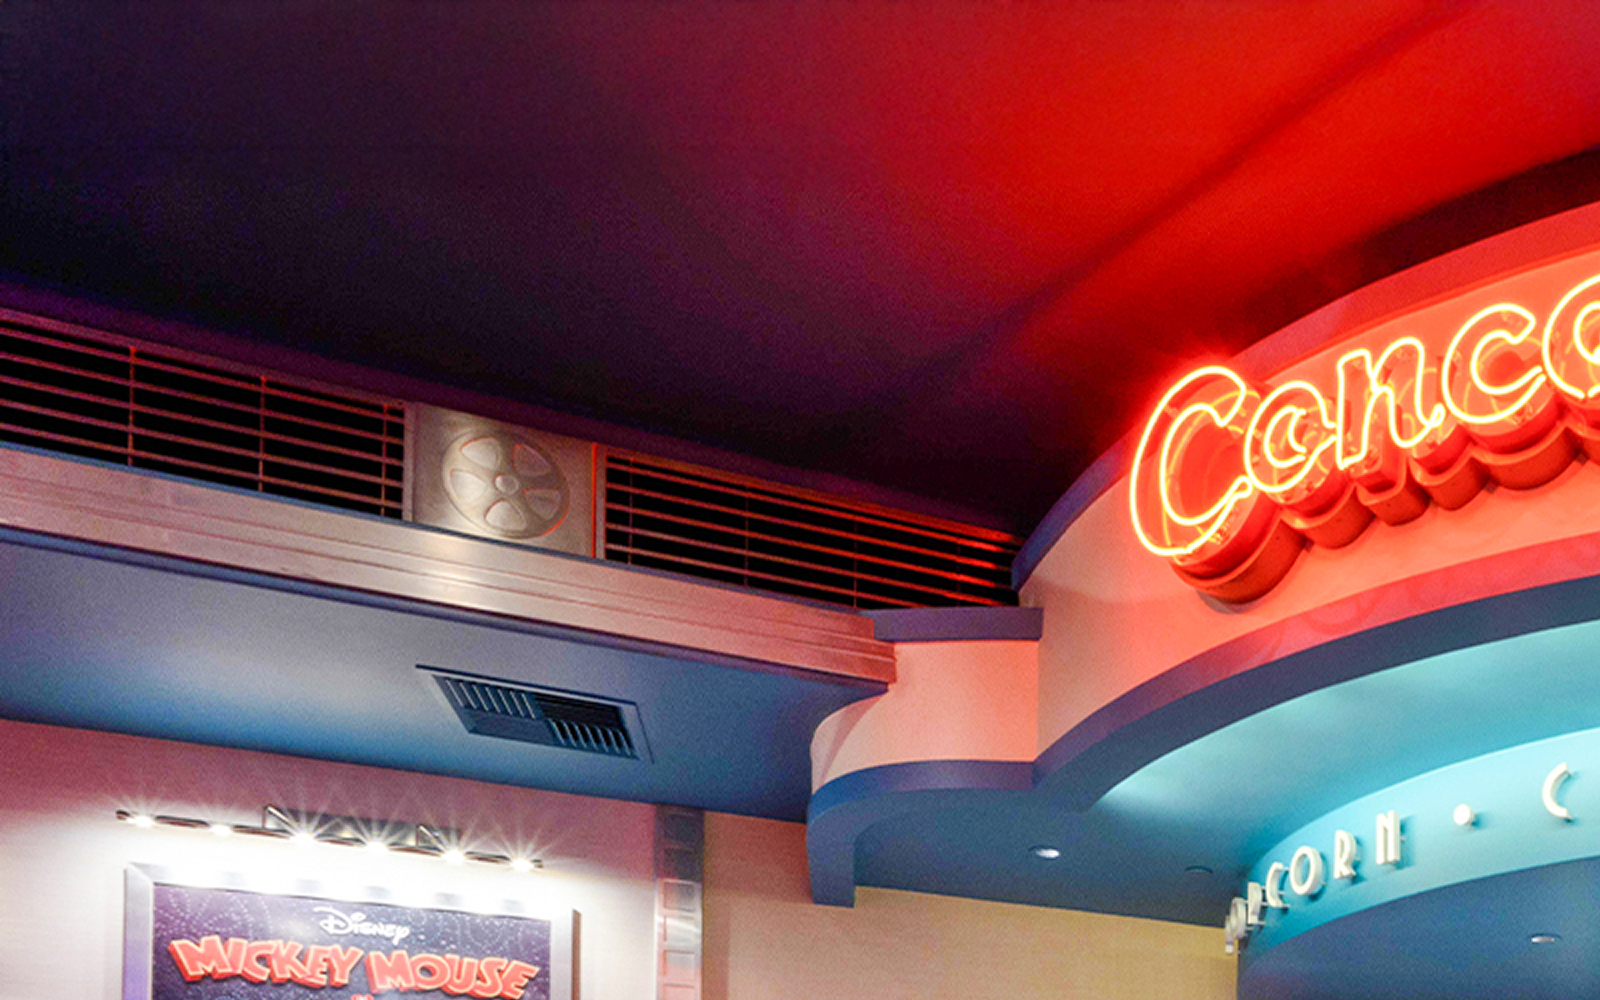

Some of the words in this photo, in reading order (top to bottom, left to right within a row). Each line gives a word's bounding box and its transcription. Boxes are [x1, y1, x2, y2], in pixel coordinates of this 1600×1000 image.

[1225, 810, 1402, 953] OPCORN
[167, 934, 364, 988] MICKEY
[363, 949, 541, 1000] MOUSE
